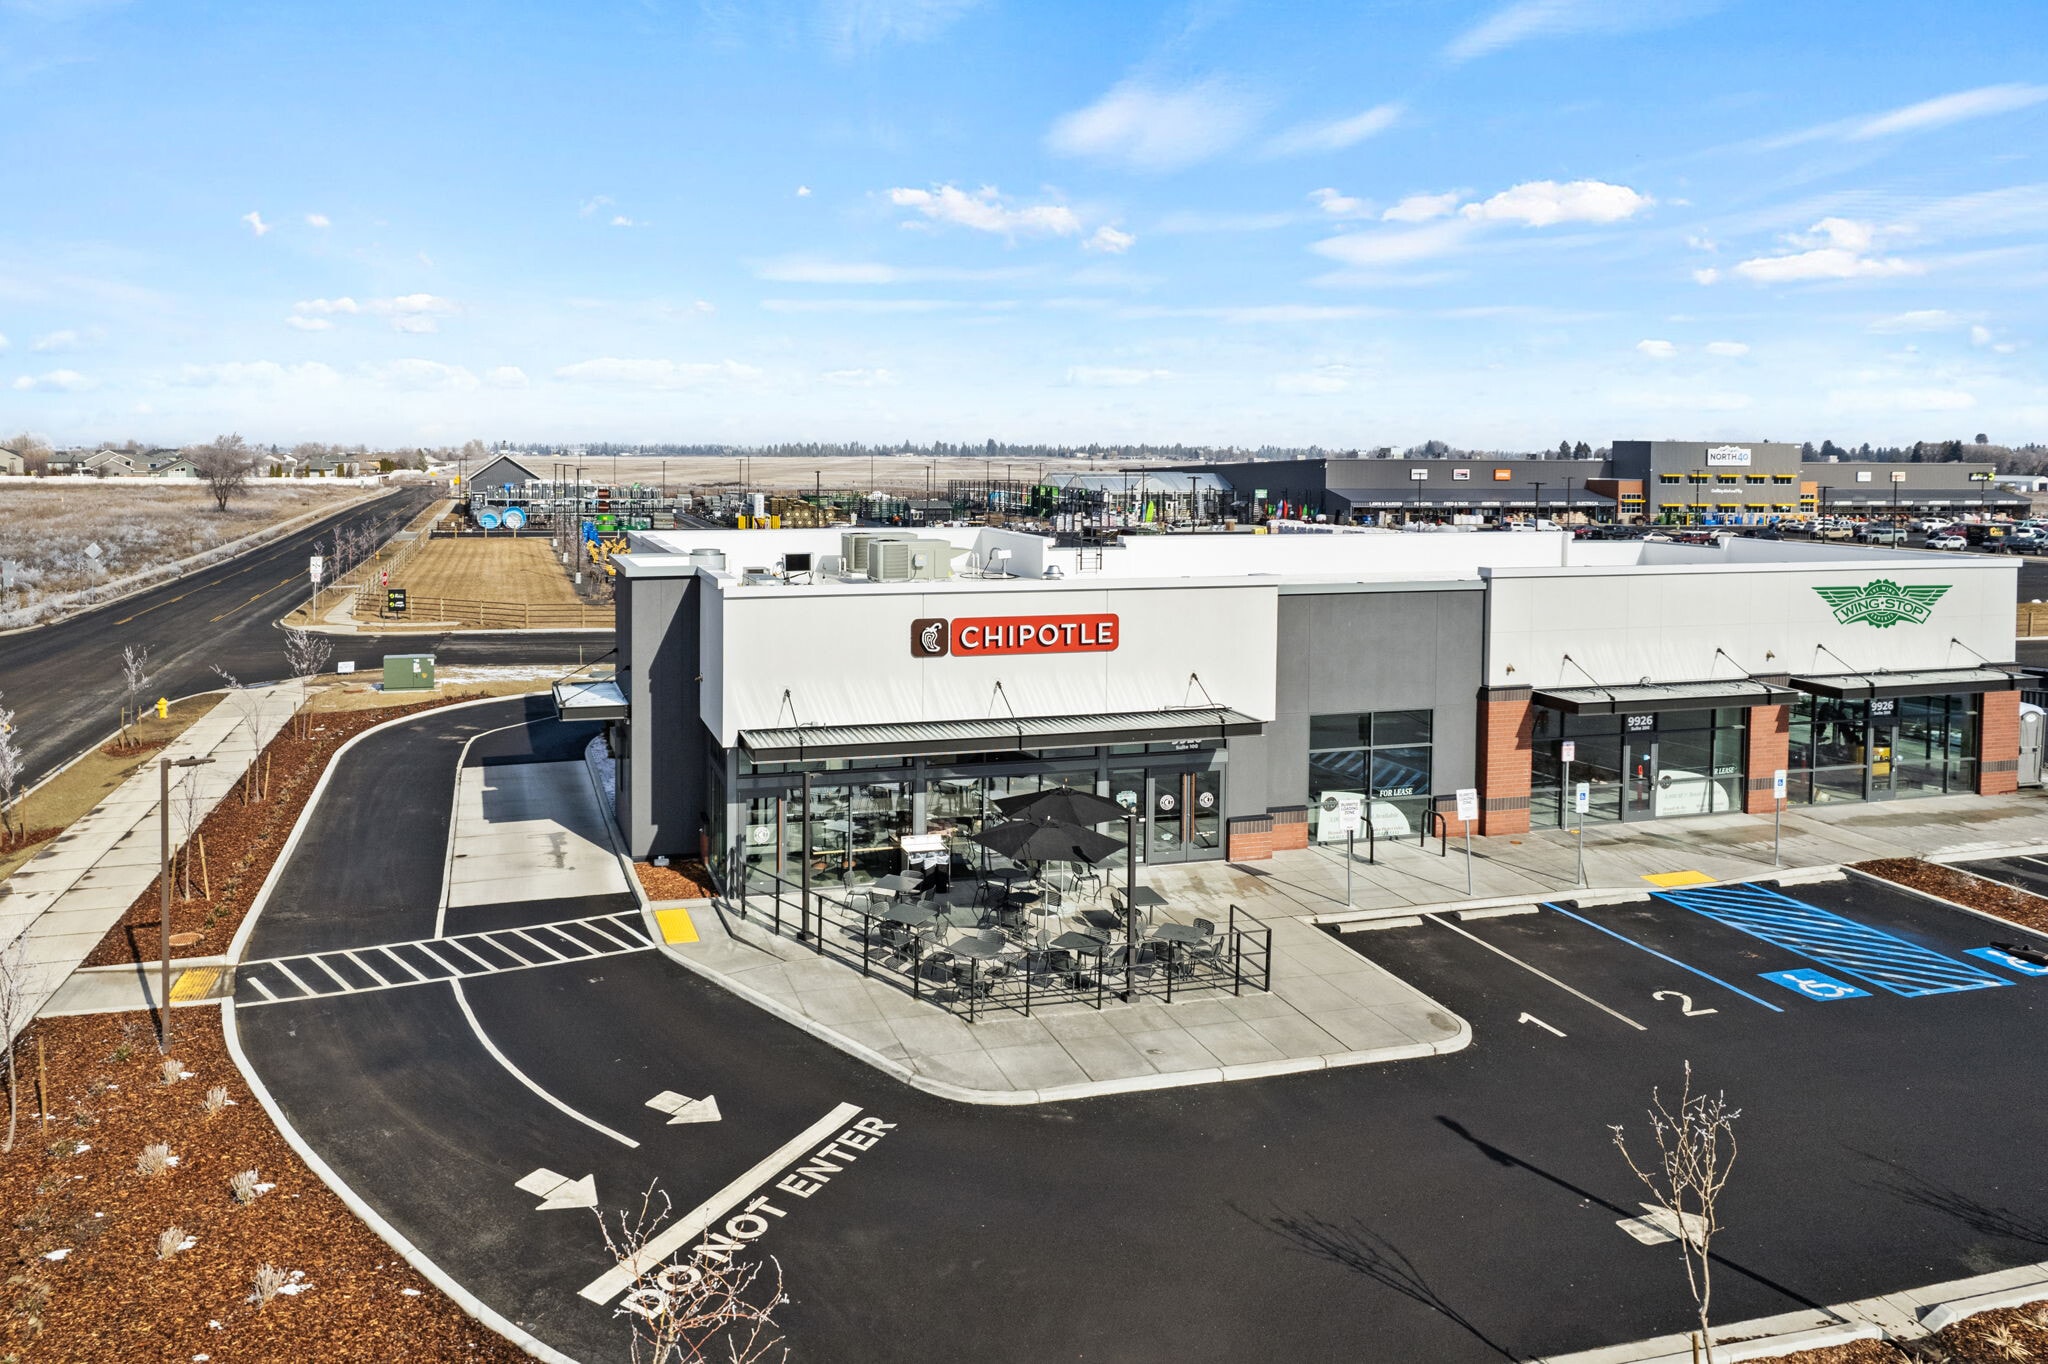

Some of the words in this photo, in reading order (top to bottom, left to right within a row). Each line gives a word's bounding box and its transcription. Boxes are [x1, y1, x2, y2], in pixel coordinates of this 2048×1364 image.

[1738, 452, 1749, 461] 40
[1869, 587, 1880, 595] THE
[1881, 586, 1896, 595] WING
[960, 622, 1114, 648] CHIPOTLE
[1871, 701, 1894, 711] 9926
[1627, 715, 1653, 726] 9926
[1719, 766, 1735, 775] LEASE
[1379, 789, 1393, 797] FOR
[1393, 787, 1413, 796] LEASE
[1652, 990, 1719, 1016] 2
[1518, 1012, 1567, 1037] 1
[619, 1264, 702, 1320] DO
[693, 1195, 788, 1263] NOT
[775, 1116, 898, 1199] ENTER
